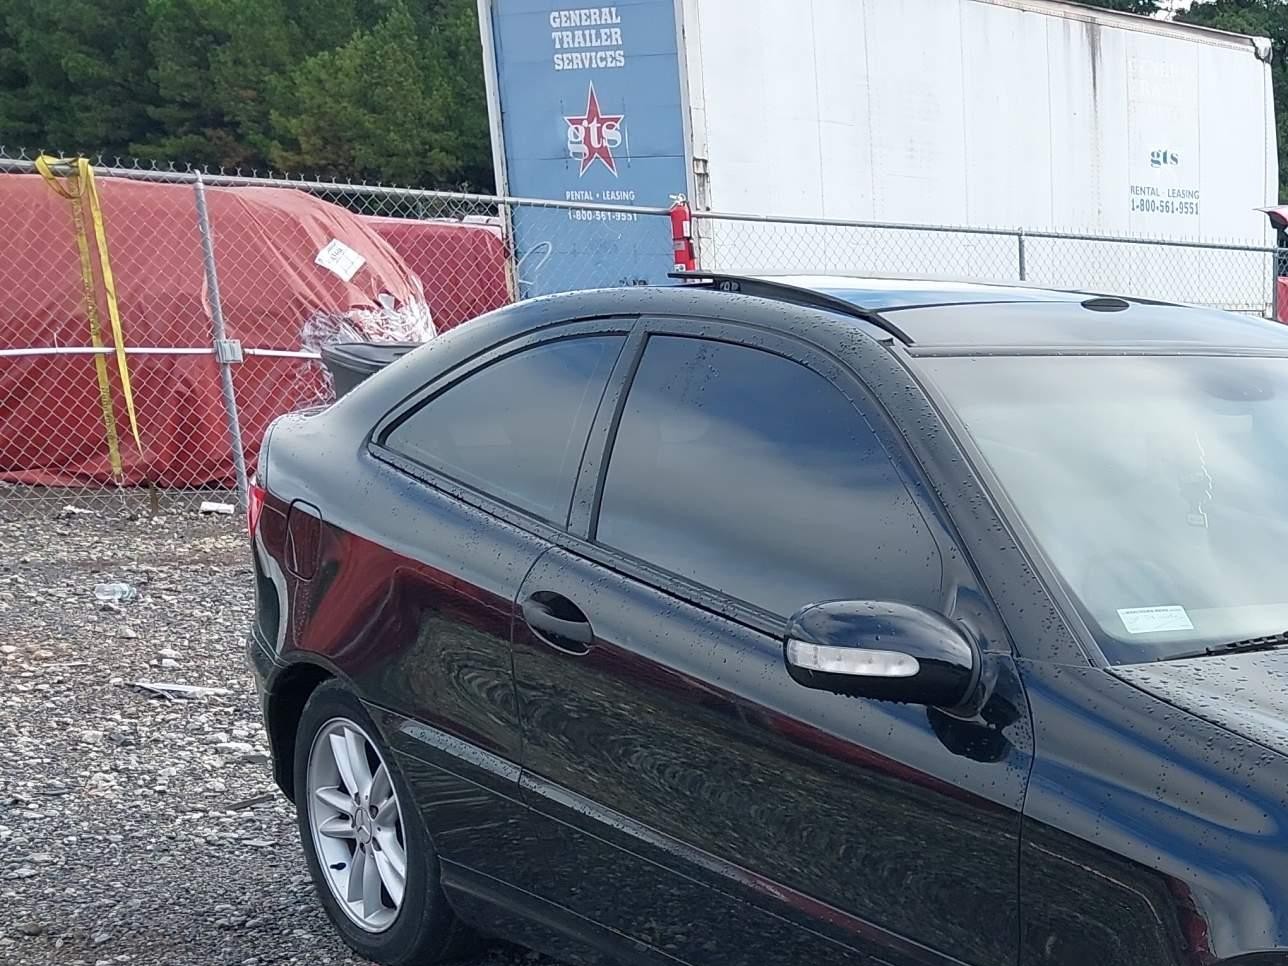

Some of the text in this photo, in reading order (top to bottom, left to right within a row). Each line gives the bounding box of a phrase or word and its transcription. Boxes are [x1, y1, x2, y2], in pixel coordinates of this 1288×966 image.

[550, 7, 621, 27] GENERAL
[551, 28, 622, 48] TRAILER
[553, 50, 625, 71] SERVICES
[567, 116, 622, 161] gts
[1150, 149, 1179, 168] gts
[566, 190, 636, 201] RENTAL LEASING
[1130, 185, 1200, 200] RENTAL LEASING
